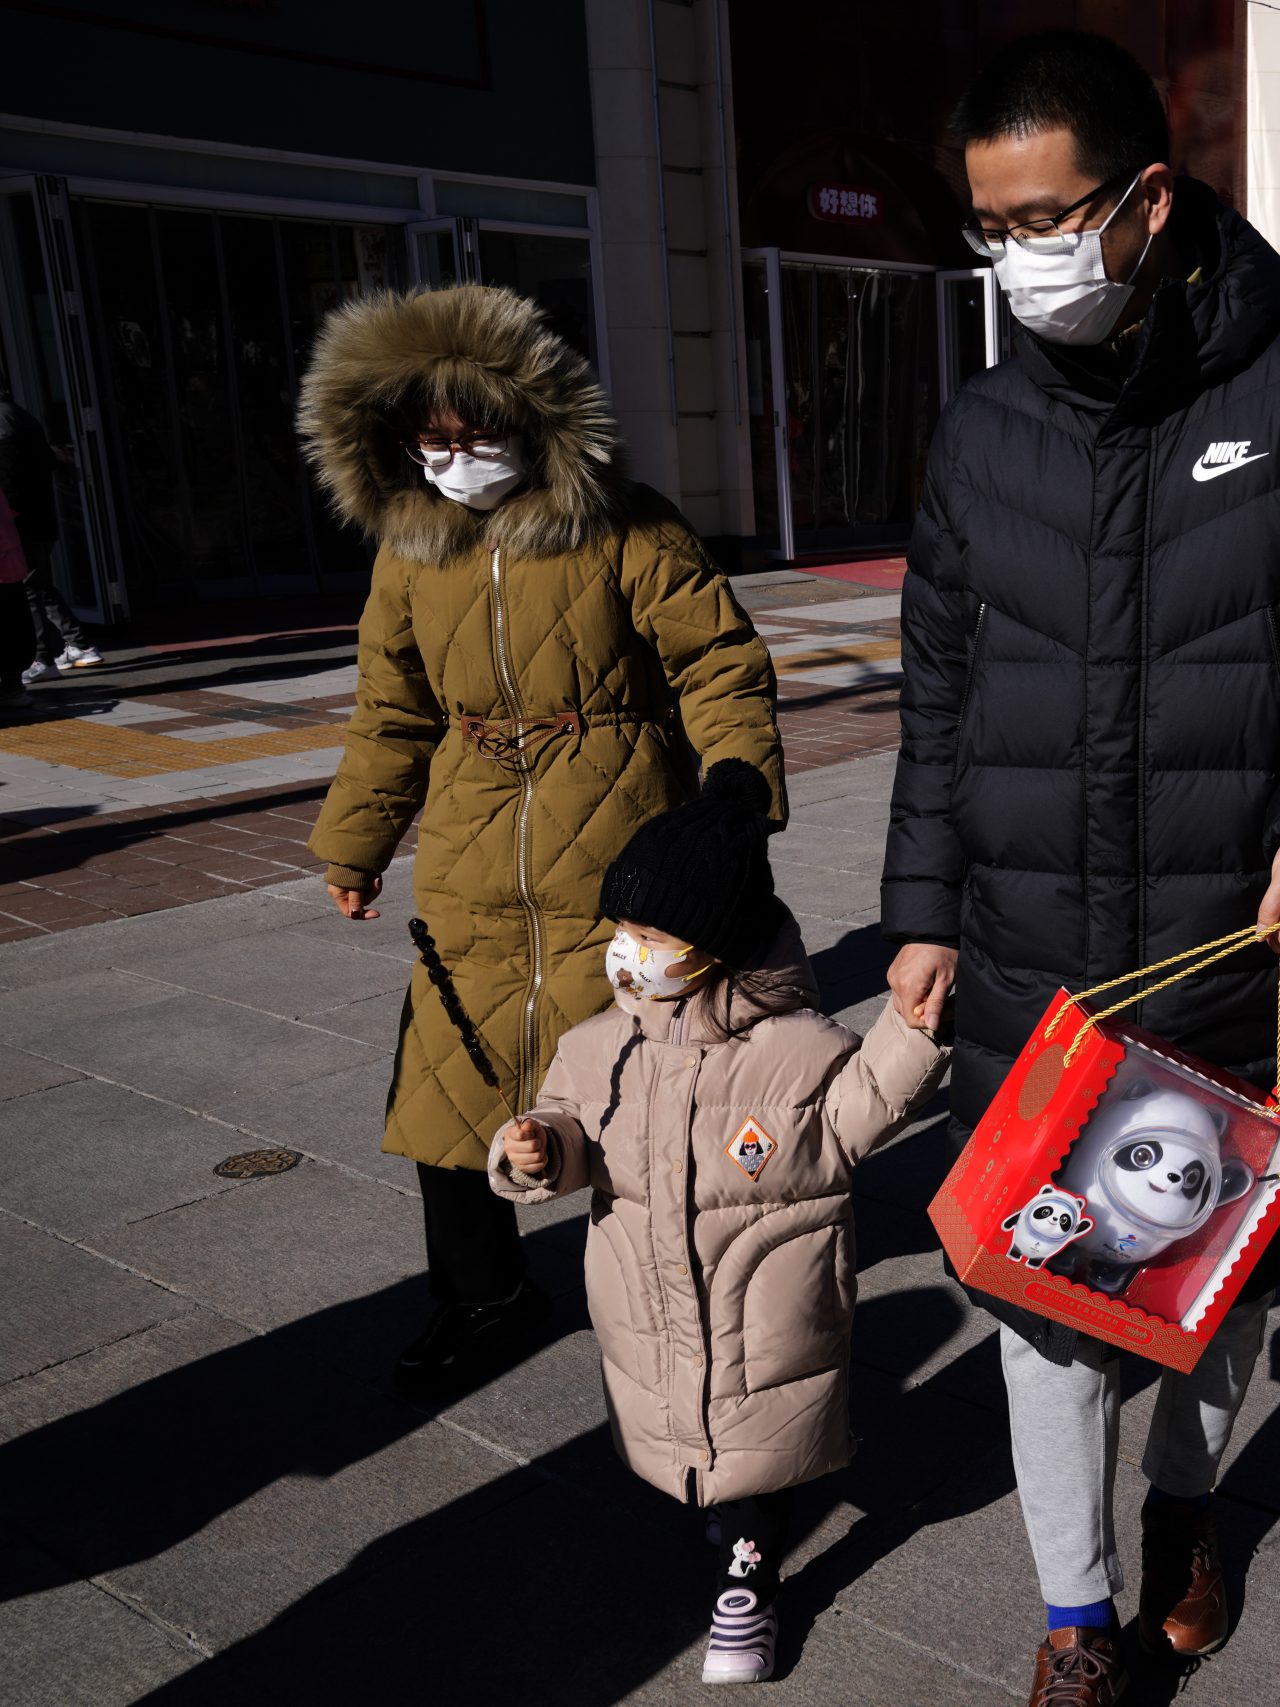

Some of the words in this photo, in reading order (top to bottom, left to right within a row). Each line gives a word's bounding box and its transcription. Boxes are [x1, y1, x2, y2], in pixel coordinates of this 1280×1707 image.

[819, 187, 878, 219] 好想你
[1203, 441, 1251, 463] NIKE
